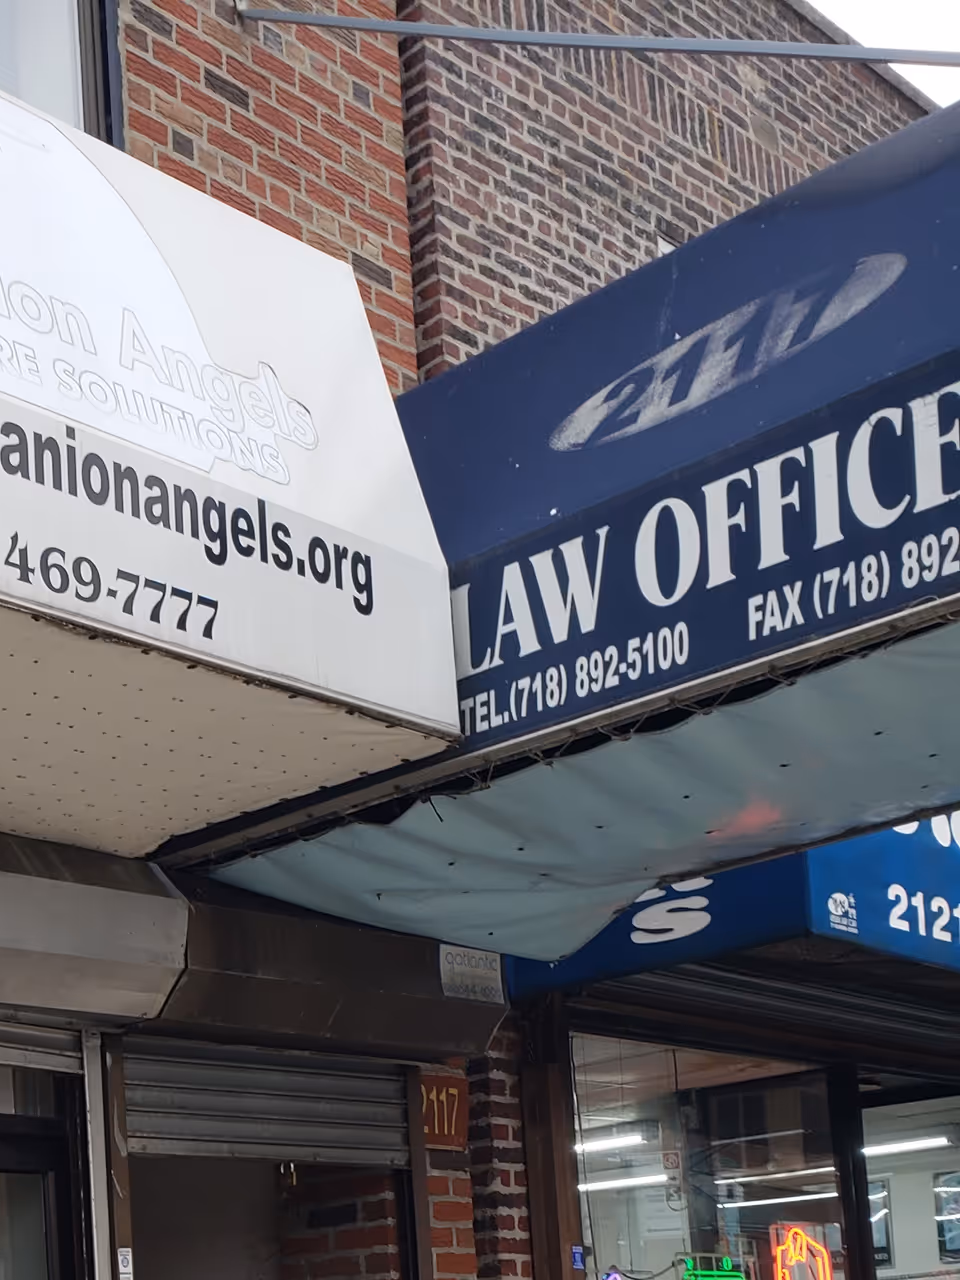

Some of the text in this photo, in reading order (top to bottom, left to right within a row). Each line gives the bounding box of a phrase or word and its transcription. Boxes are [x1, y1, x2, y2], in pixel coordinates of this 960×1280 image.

[52, 358, 283, 476] SOLUTIONS
[119, 306, 314, 446] Angels
[450, 525, 611, 681] LAW
[747, 580, 805, 641] FAX
[812, 550, 890, 620] (718)
[574, 620, 690, 698] 892-5100
